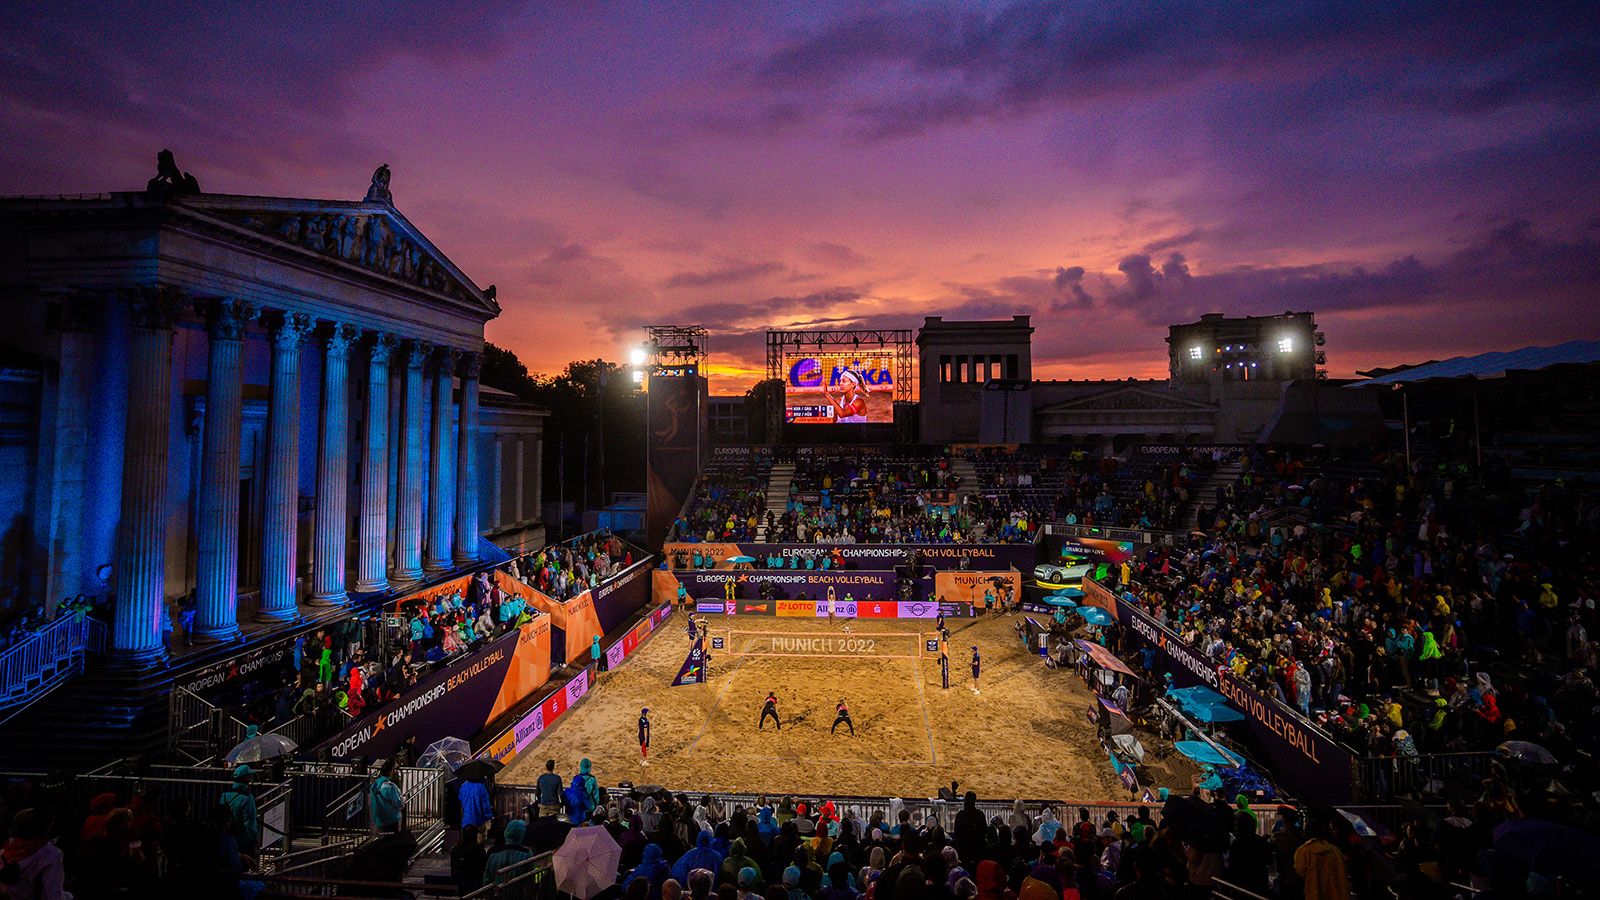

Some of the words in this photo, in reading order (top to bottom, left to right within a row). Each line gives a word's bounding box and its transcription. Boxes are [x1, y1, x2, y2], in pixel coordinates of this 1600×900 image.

[714, 447, 750, 455] EUROPEAN
[704, 548, 725, 556] 2022
[782, 548, 828, 557] EUROPEAN
[842, 549, 908, 558] CHAMPIONSHIPS
[916, 548, 939, 557] EACH
[940, 548, 995, 558] VOLLEYBALL
[696, 575, 736, 583] EUROPEAN
[749, 575, 807, 584] CHAMPIONSHIPS
[808, 576, 834, 584] BEACH
[835, 576, 884, 584] VOLLEYBALL
[954, 576, 990, 585] MUNICH
[788, 603, 813, 611] LOTTO
[816, 605, 845, 614] Allnz
[771, 637, 832, 652] MUNICH
[838, 639, 875, 653] 2022
[387, 682, 447, 727] CHAMPIONSHIPS
[446, 669, 469, 693] BEACH
[467, 648, 505, 683] VOLLEYBALL
[1132, 615, 1159, 645] EUROPEAN
[1167, 640, 1219, 689] CHAMPIONSHIPS
[1219, 678, 1249, 712] BEACH
[1249, 695, 1322, 765] VOLLEYBALL
[515, 721, 536, 746] Allianz
